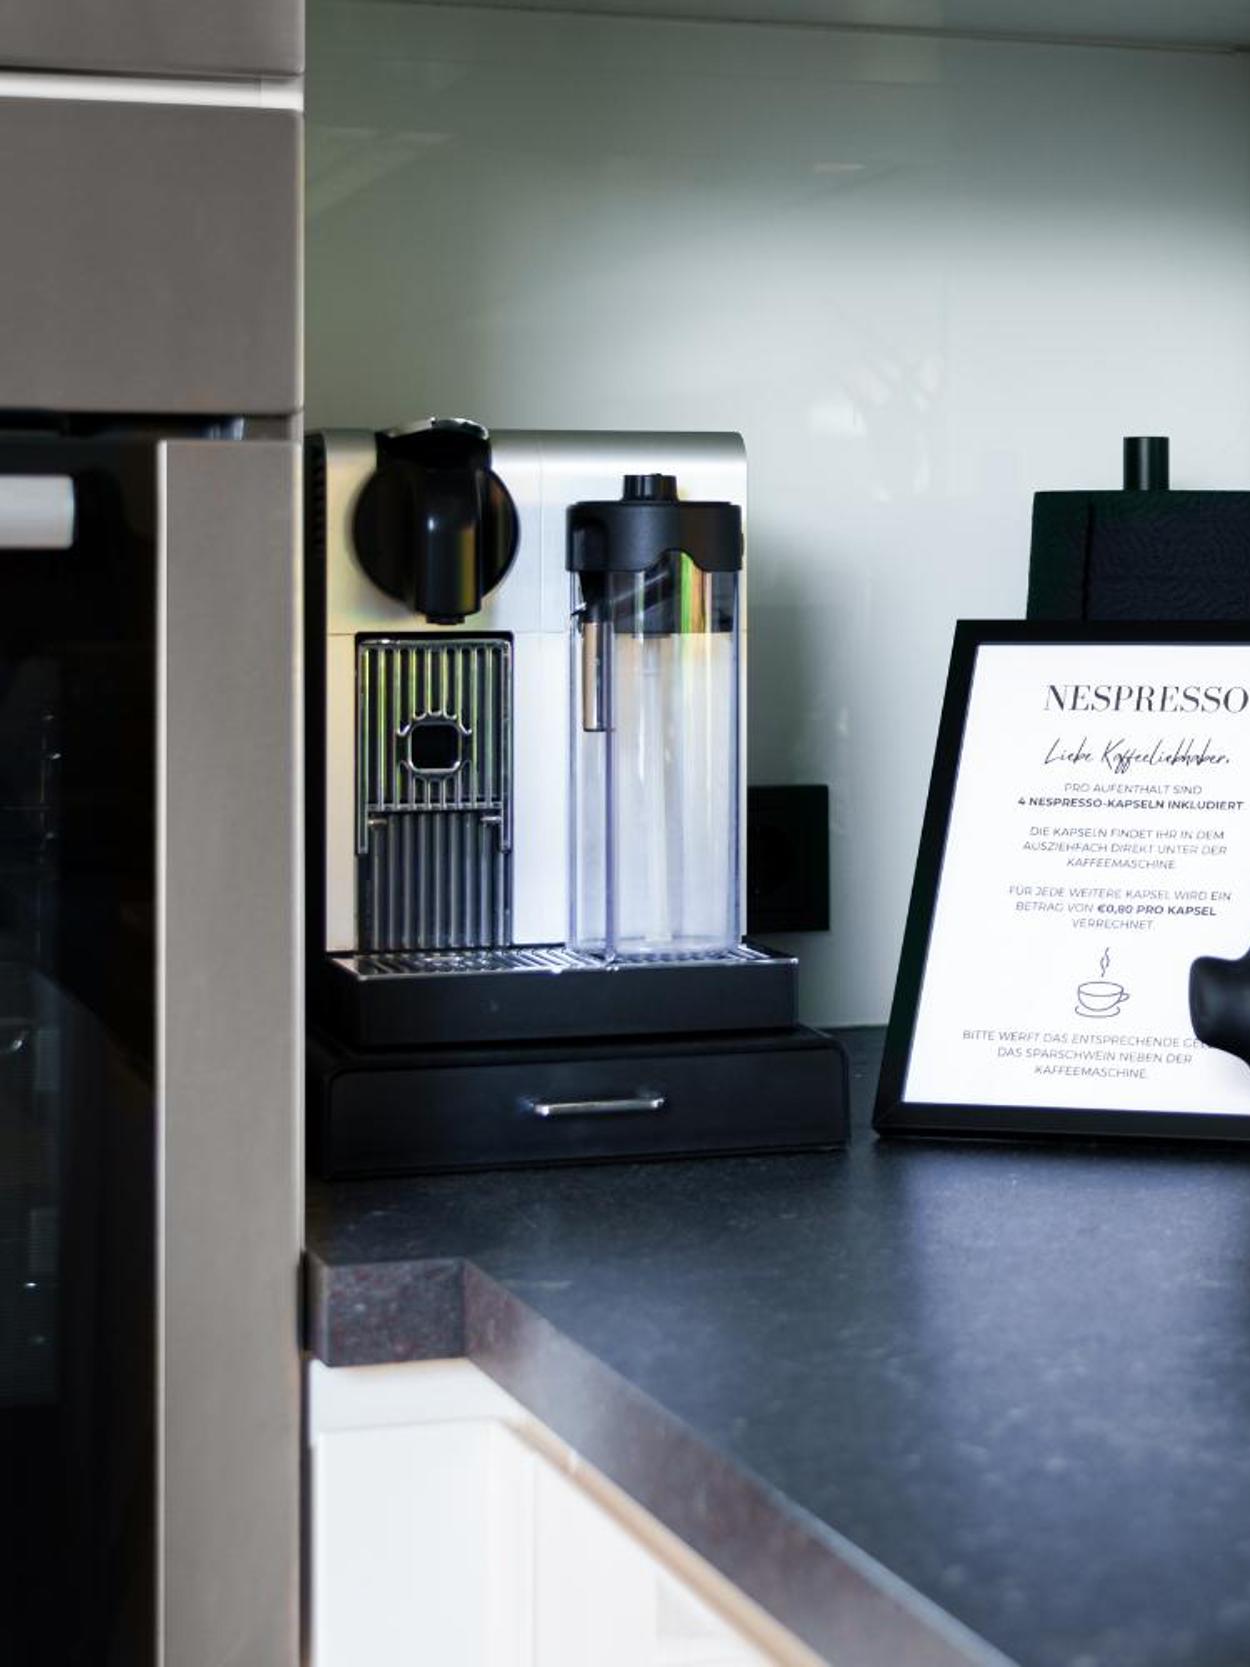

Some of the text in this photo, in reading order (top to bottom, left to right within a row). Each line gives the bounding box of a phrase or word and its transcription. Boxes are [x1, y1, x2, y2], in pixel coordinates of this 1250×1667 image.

[1043, 684, 1249, 714] NESPRESSO
[1044, 736, 1095, 764] Liebe
[1064, 783, 1203, 795] PRO AUFENTHALT SIND
[1017, 797, 1026, 806] 4
[1029, 797, 1165, 809] NESPRESSO-KAPSELN
[1029, 826, 1225, 840] DIE KAPSELN FINDET IHR IN DEM
[1023, 841, 1228, 855] AUSZIEHFACH DIREKT UNTER DER
[1009, 884, 1232, 901] FÜR JEDE WEITERE KAPSEL WIRD EIN
[1015, 901, 1217, 916] BETRAG VON €0,80 PRO KAPSEL
[963, 1030, 995, 1041] BITTE
[998, 1031, 1040, 1042] WERFT
[1043, 1032, 1068, 1044] DAS
[1071, 1033, 1179, 1048] ENTSPRECHENDE
[997, 1046, 1193, 1064] DAS SPARSCHWEIN NEBEN DER
